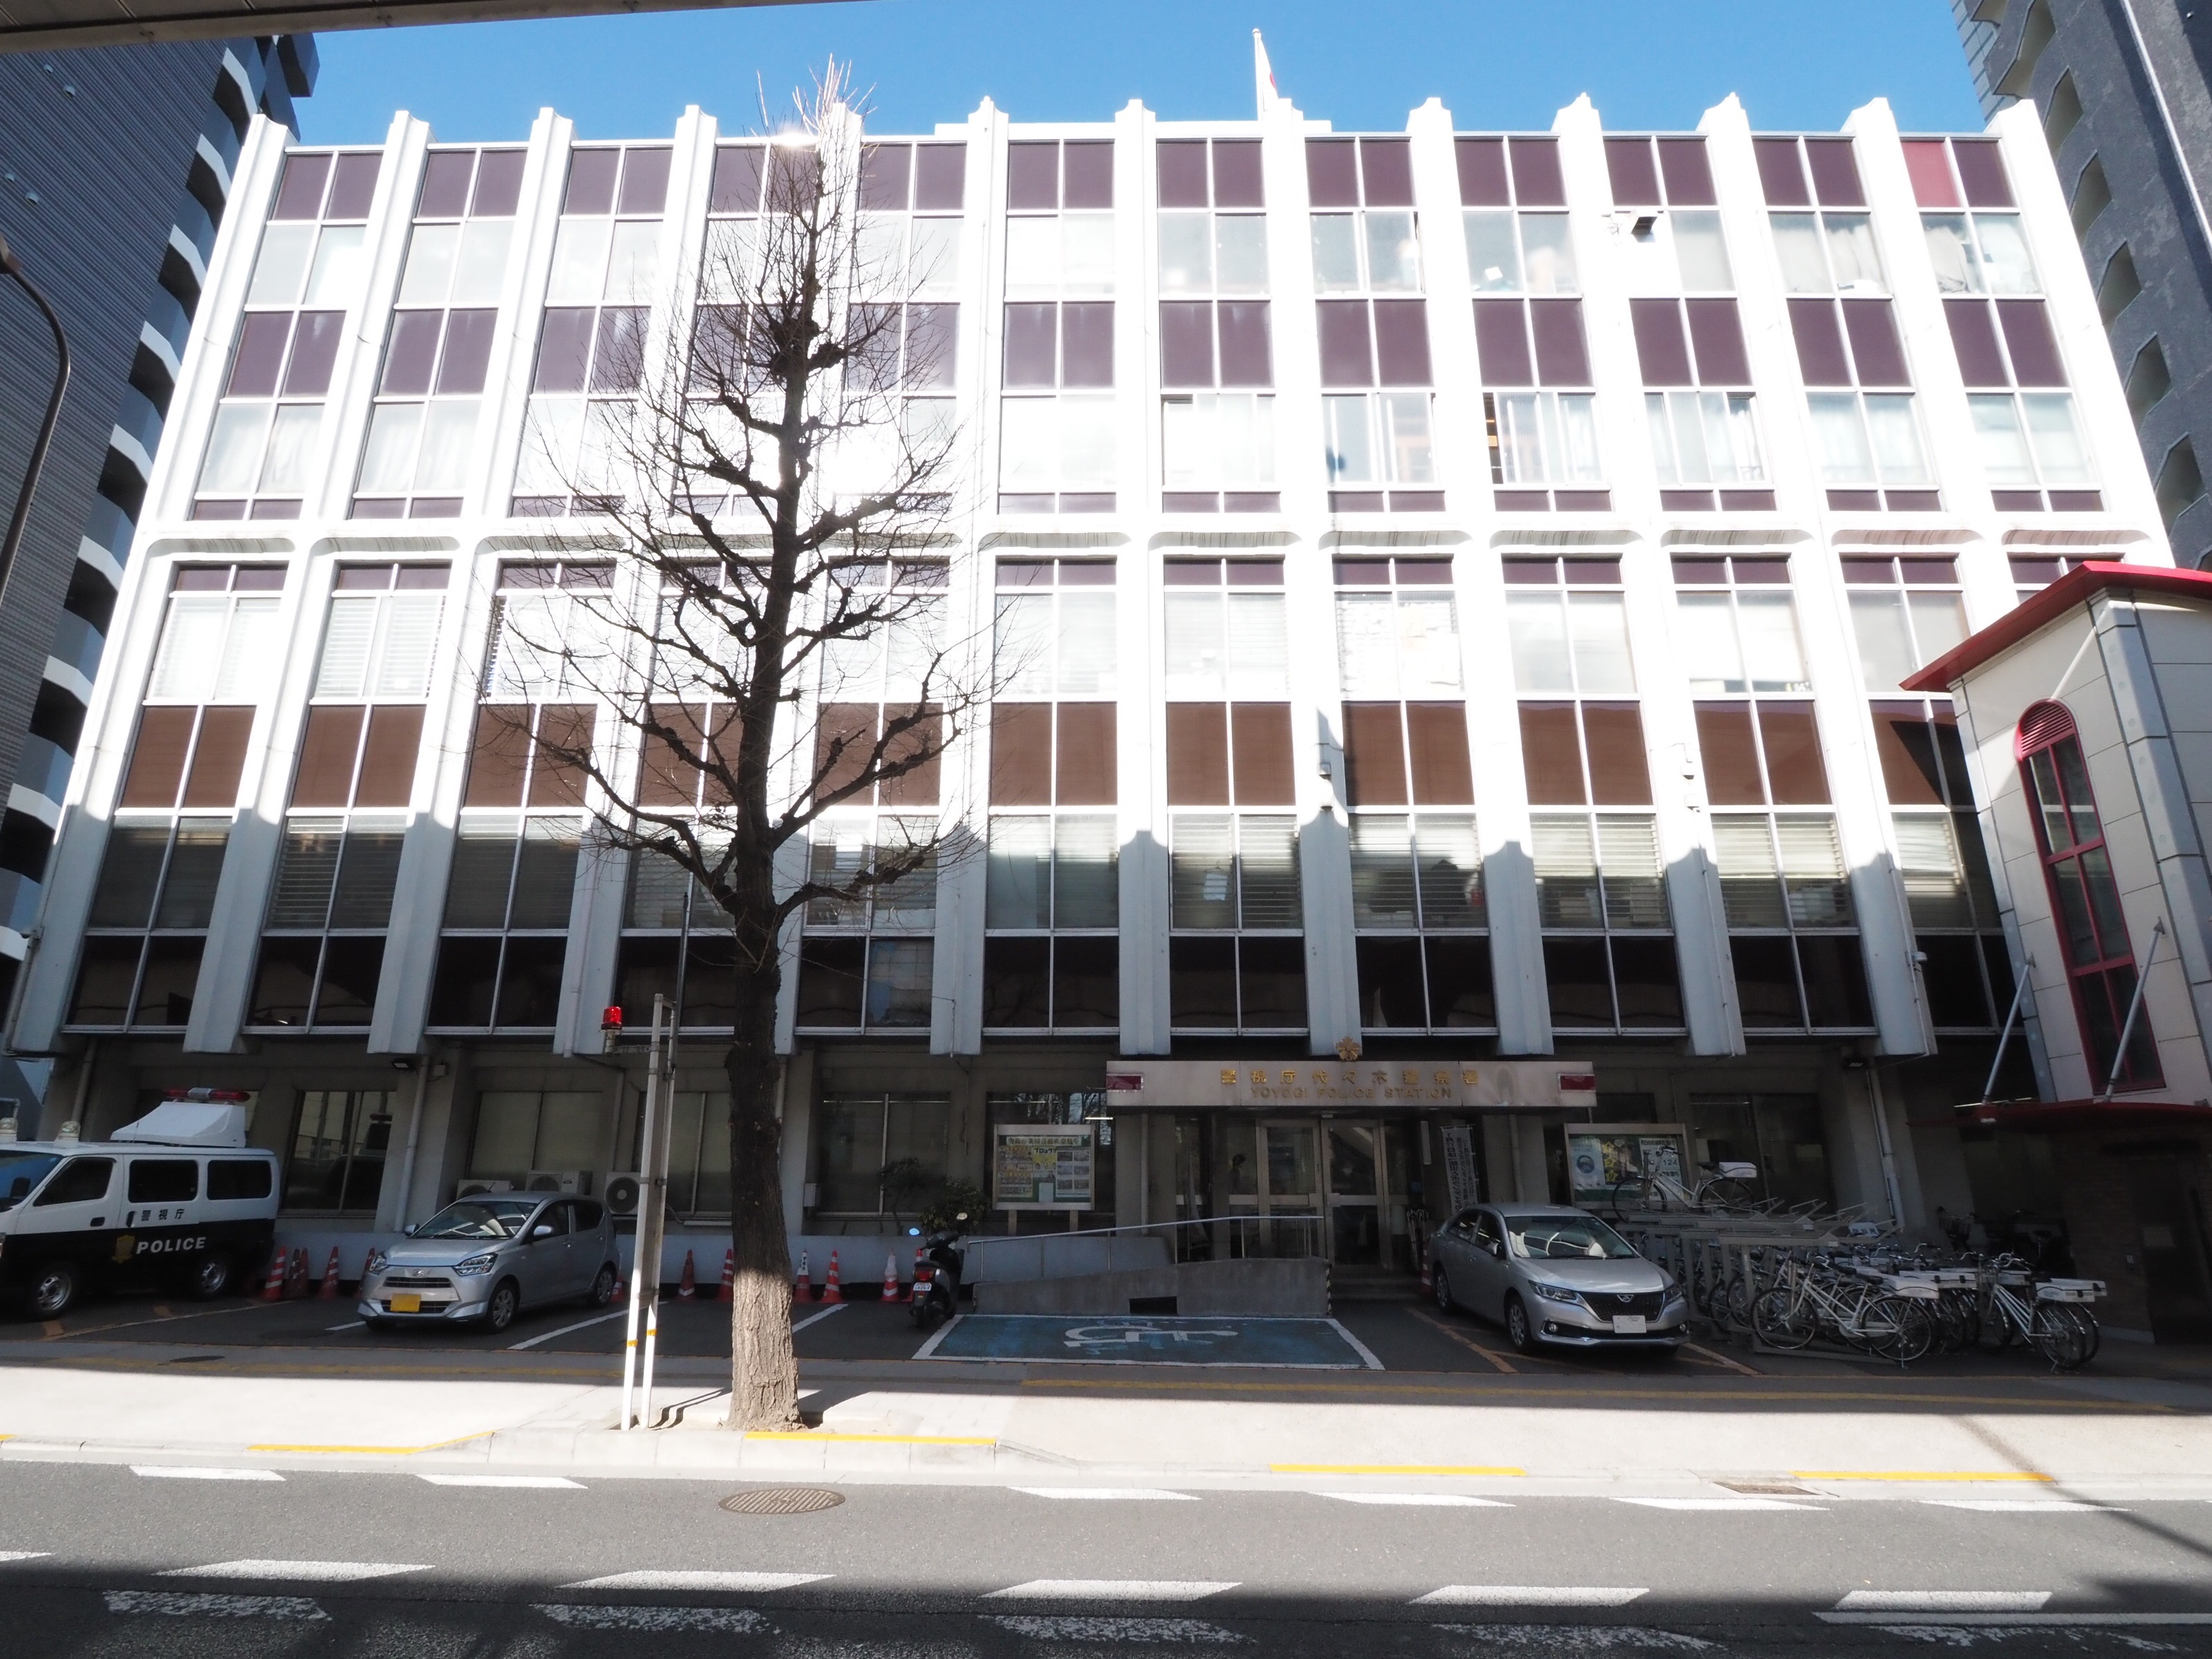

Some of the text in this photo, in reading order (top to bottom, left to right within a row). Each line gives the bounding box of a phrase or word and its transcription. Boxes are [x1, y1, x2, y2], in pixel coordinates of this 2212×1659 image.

[1221, 1069, 1478, 1085] 警視庁代々木警察署
[1250, 1086, 1452, 1100] YOYOGI POLICE STATION
[141, 1208, 185, 1221] 警視庁
[135, 1237, 206, 1255] POLICE
